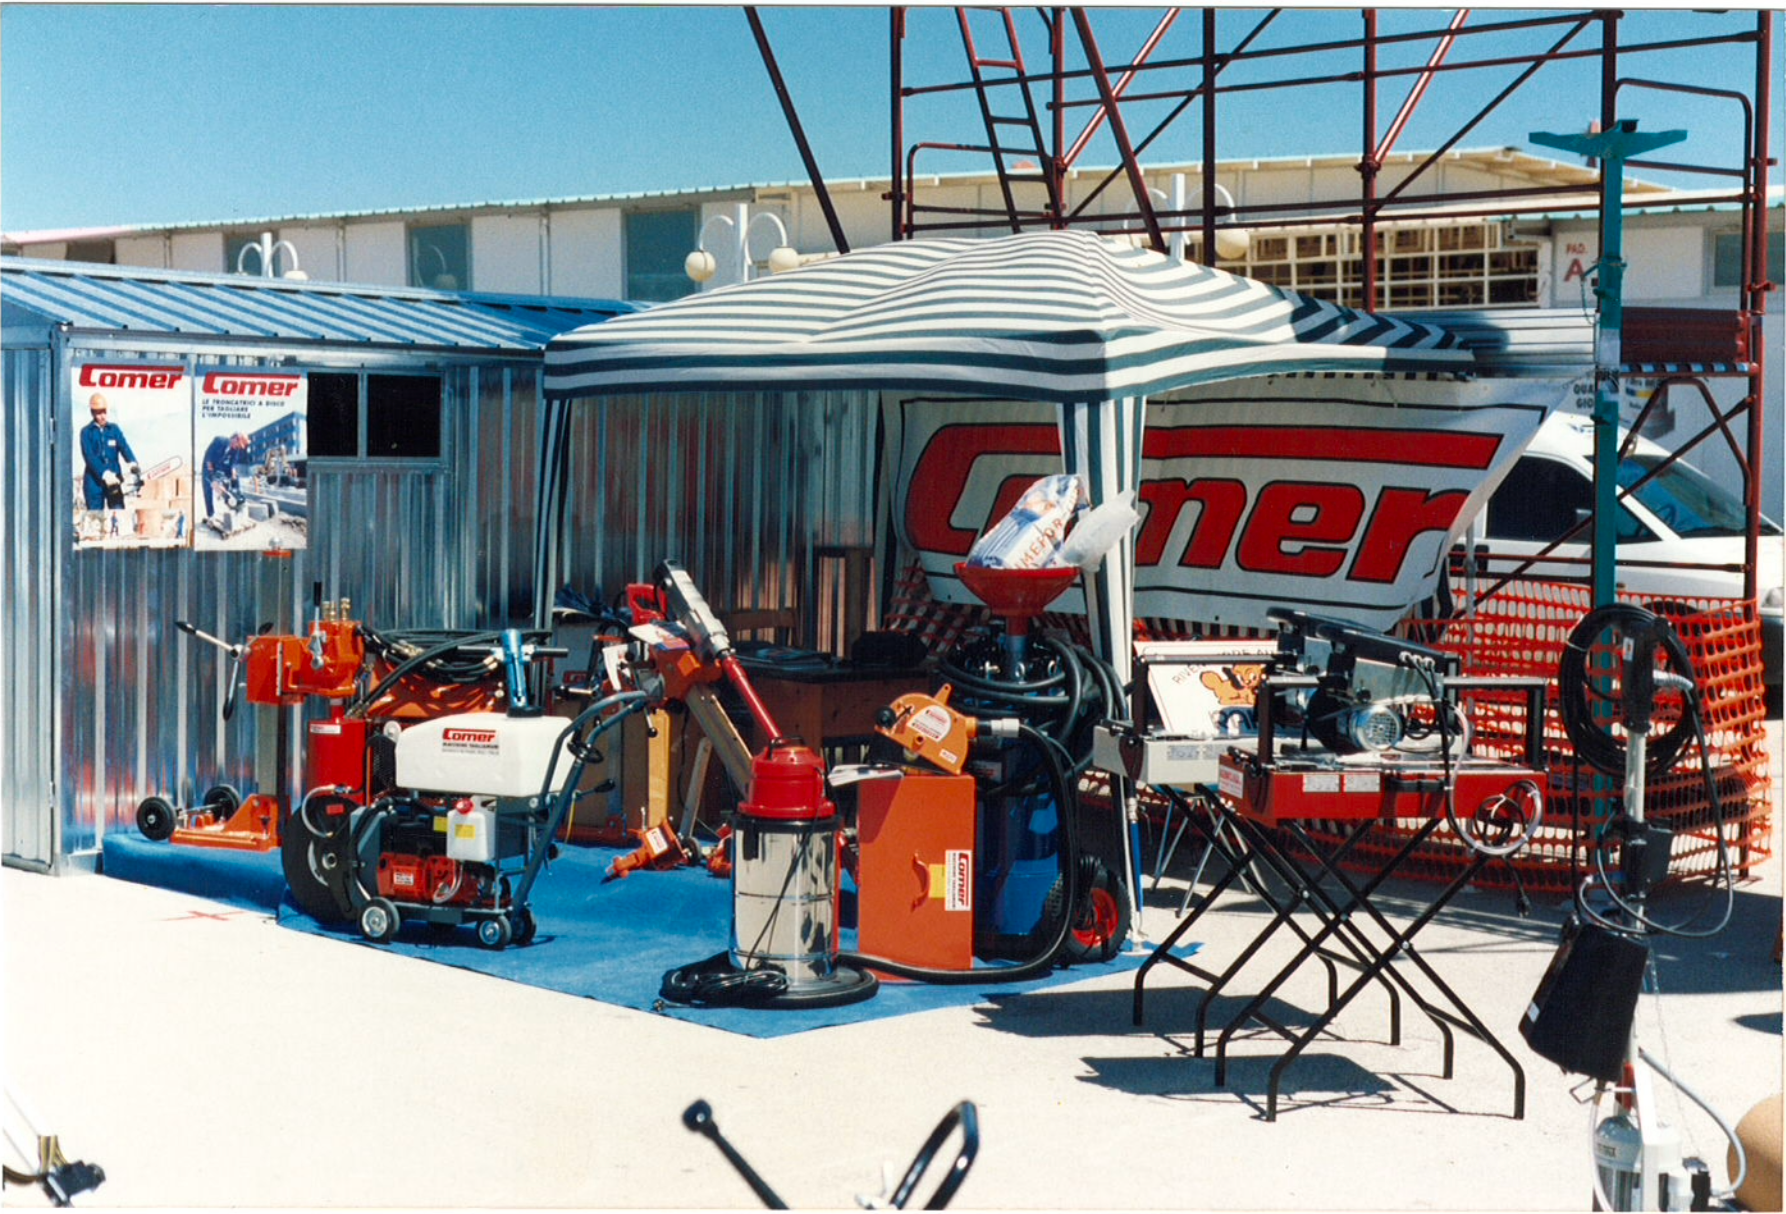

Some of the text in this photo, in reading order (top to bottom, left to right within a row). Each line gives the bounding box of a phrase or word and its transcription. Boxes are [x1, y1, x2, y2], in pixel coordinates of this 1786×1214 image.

[1564, 258, 1585, 282] A
[79, 363, 185, 389] Comer
[202, 372, 301, 396] Comer
[442, 727, 496, 742] Comer
[958, 852, 969, 907] Comer
